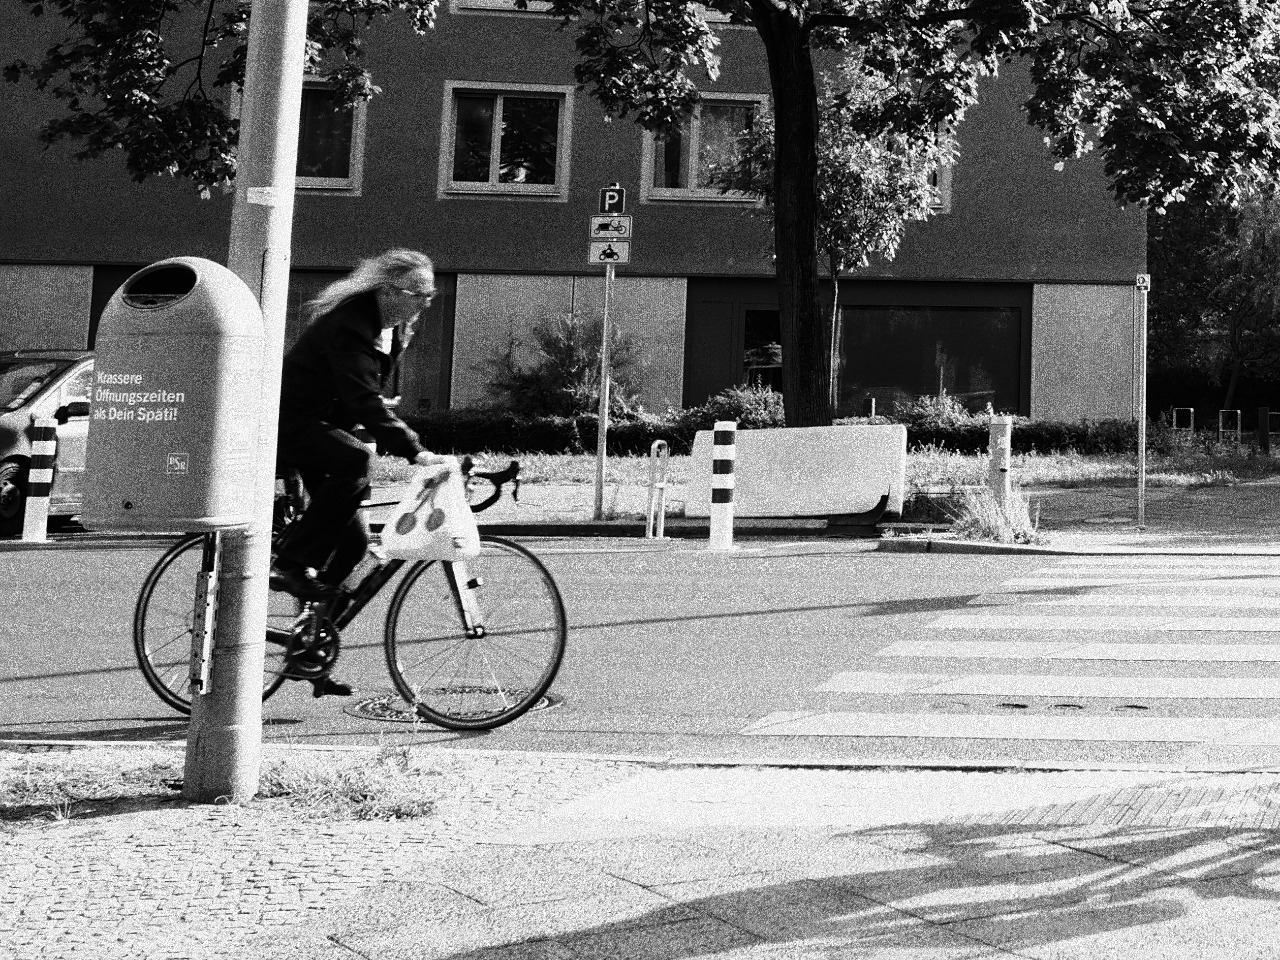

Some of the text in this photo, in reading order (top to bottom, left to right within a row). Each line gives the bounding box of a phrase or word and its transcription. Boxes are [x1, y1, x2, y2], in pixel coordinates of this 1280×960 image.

[604, 191, 619, 211] P
[97, 371, 143, 385] Krassere
[95, 386, 185, 405] Öffnungszeiten
[93, 407, 178, 424] als Dein Späti!
